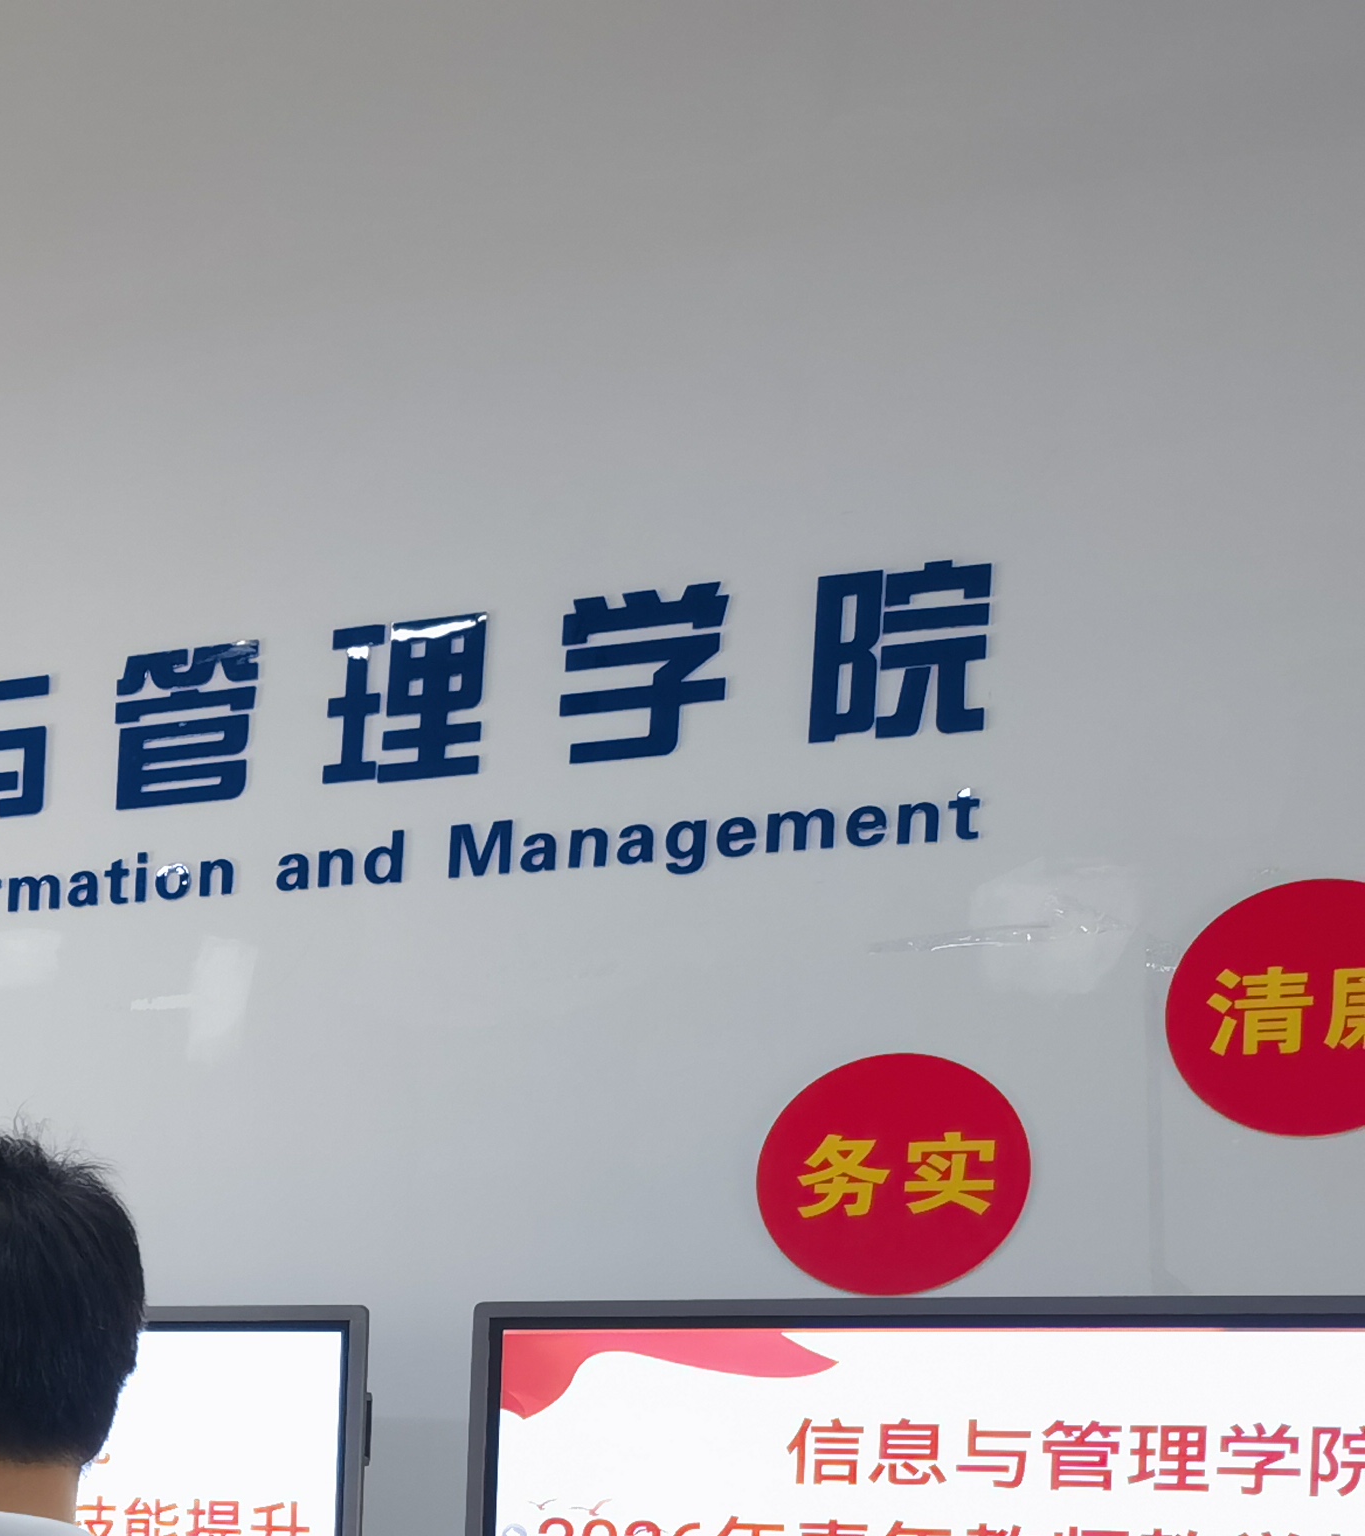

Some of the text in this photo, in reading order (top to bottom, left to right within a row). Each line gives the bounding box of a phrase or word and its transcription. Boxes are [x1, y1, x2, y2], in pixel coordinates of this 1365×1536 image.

[275, 829, 406, 893] and
[447, 786, 982, 876] Management
[797, 1131, 997, 1219] 务实
